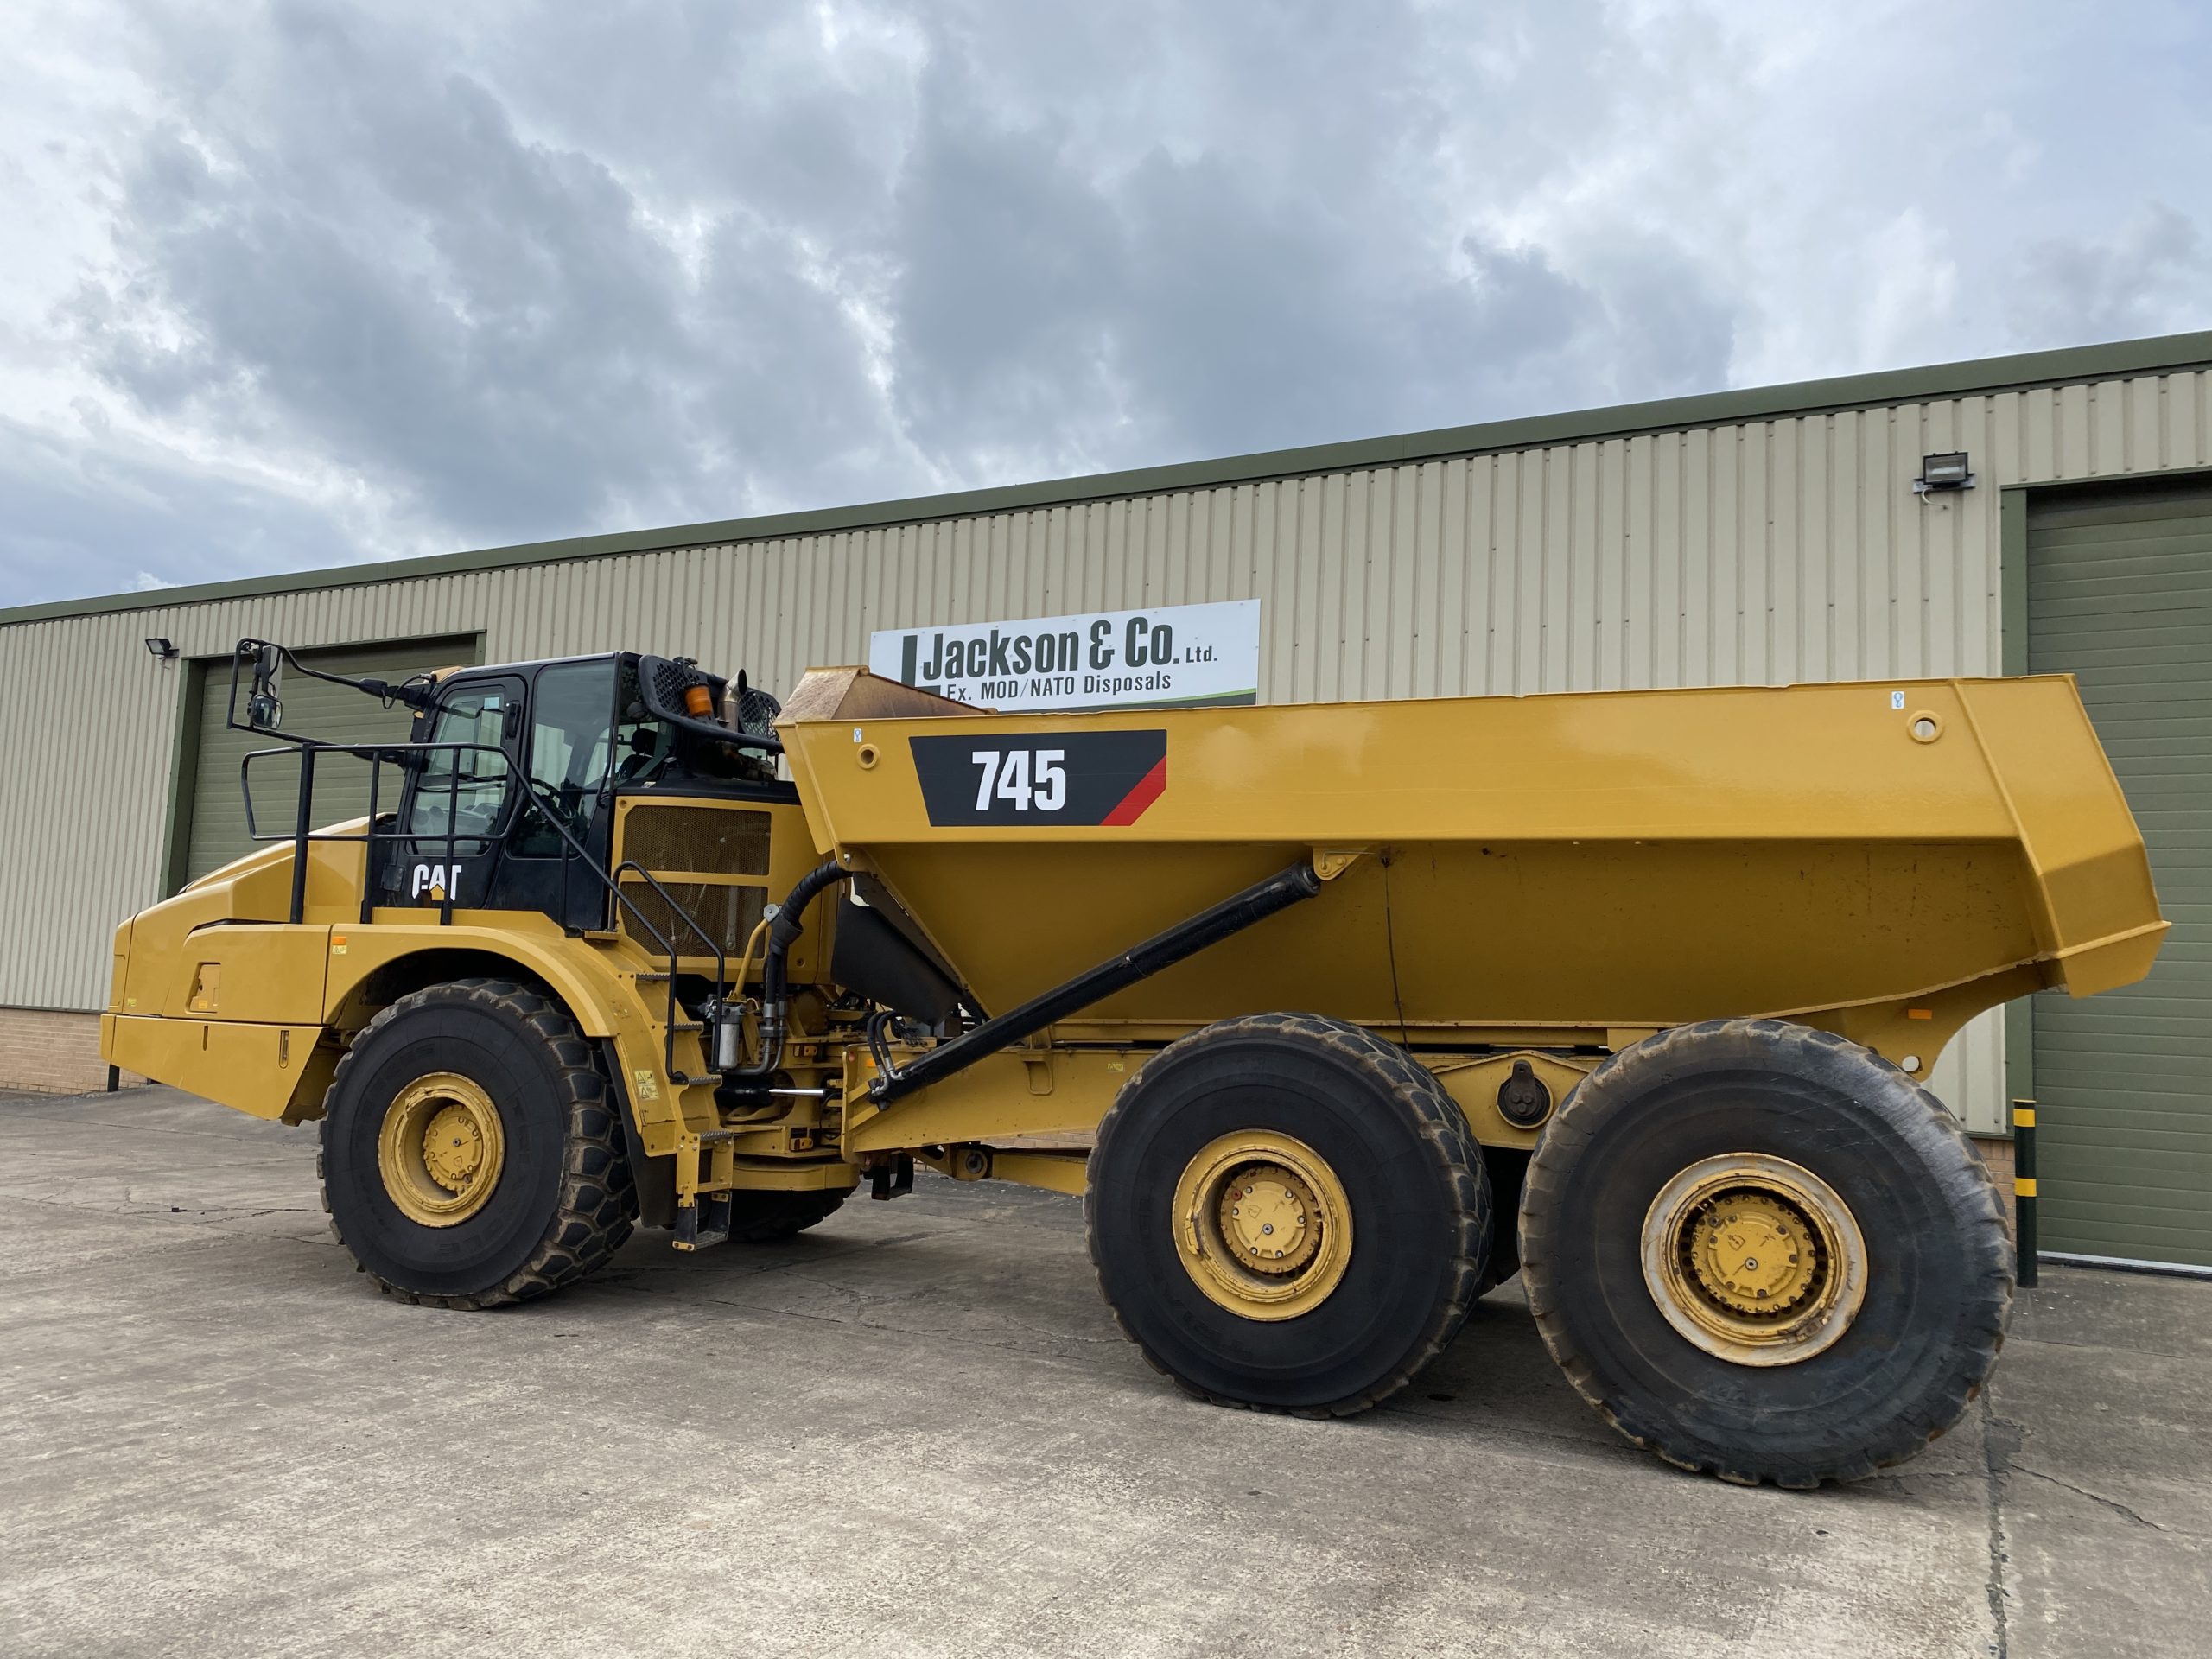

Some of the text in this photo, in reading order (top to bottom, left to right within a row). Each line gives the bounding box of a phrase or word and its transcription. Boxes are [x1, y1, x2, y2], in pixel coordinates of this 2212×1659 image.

[923, 629, 1079, 681] Jackson
[1089, 620, 1115, 670] &
[1125, 616, 1180, 667] Co.
[1185, 645, 1217, 664] Ltd.
[947, 671, 1172, 701] Ex. MOD/NATO Disposals
[972, 749, 1066, 811] 745
[412, 864, 462, 901] CAT
